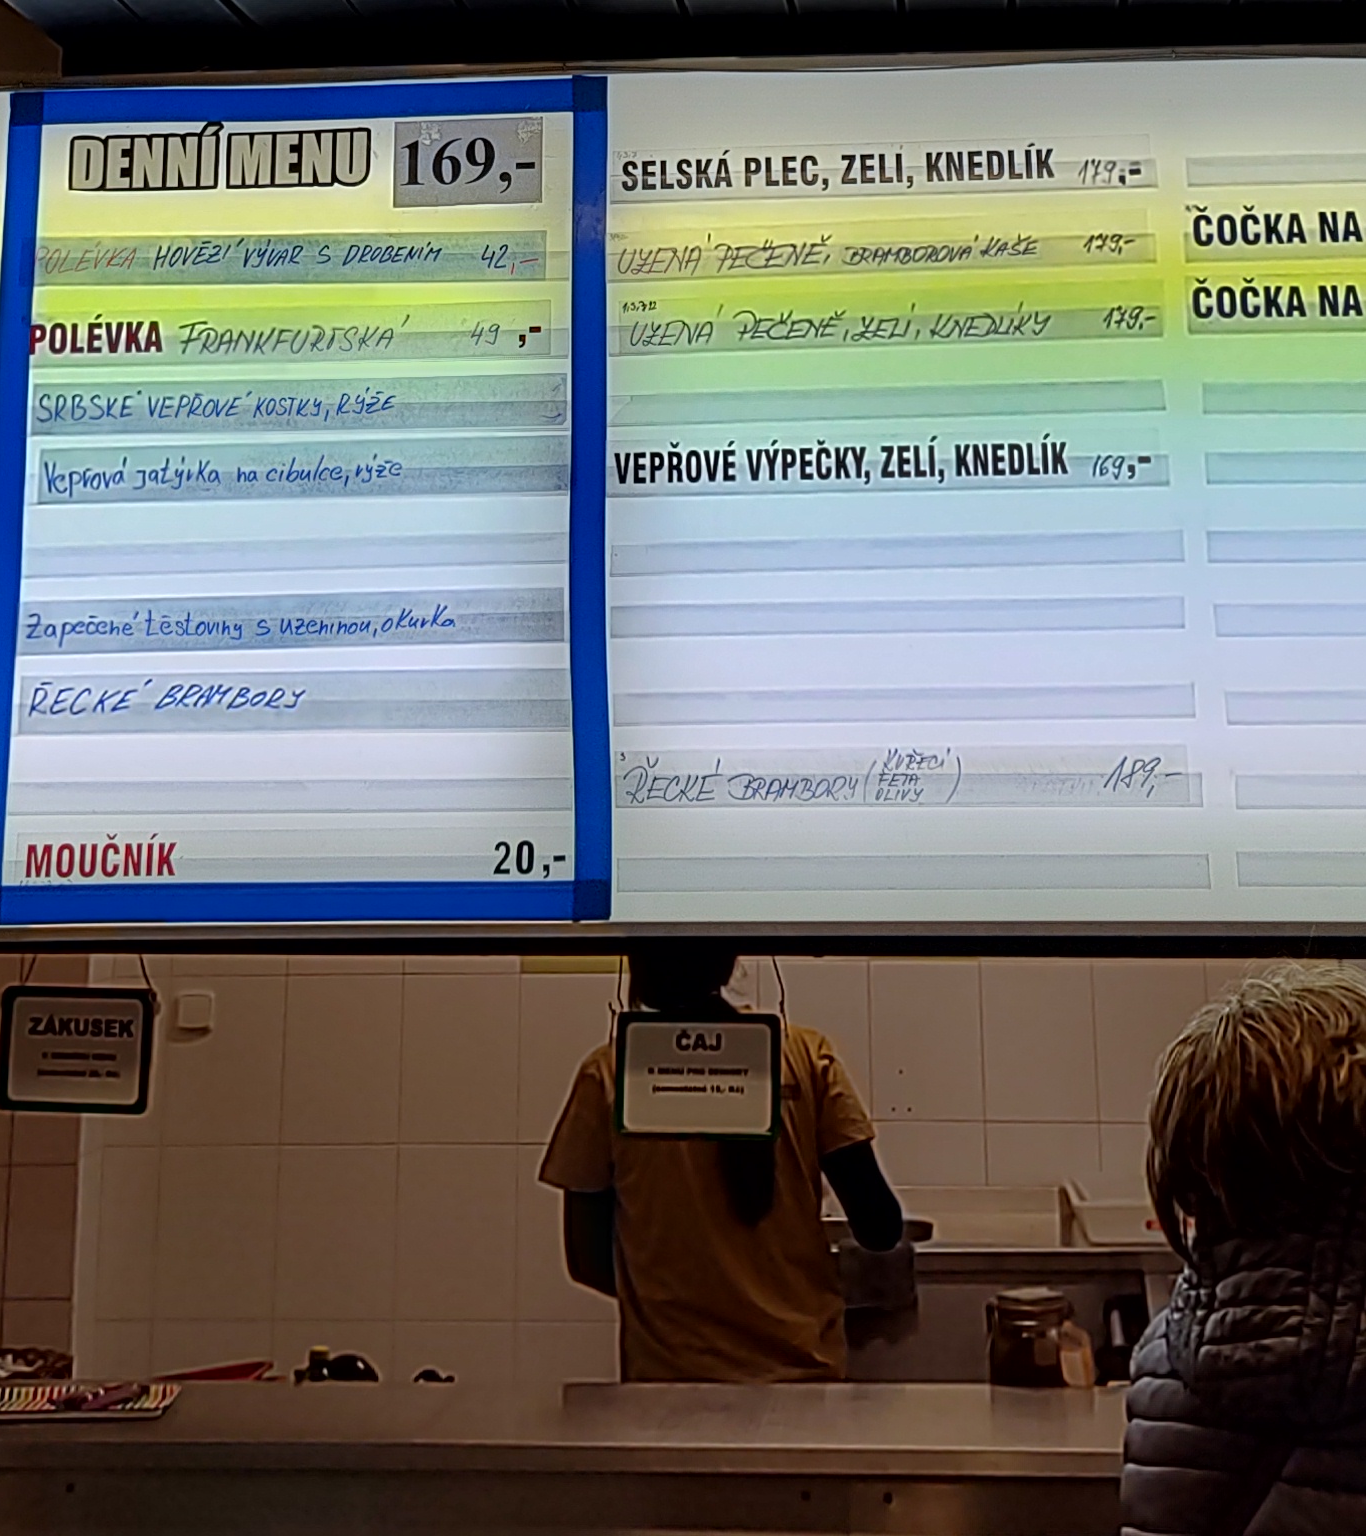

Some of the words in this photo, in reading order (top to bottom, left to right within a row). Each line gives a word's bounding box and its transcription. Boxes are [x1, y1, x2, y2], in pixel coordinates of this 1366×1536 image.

[68, 122, 225, 192] DENNÍ
[225, 128, 372, 189] MENU
[399, 137, 536, 194] 169,-
[621, 150, 733, 192] SELSKÁ
[744, 154, 829, 192] PLEC,
[841, 145, 915, 188] ZELÍ,
[925, 142, 1054, 183] KNEDLÍK
[1191, 205, 1307, 247] ČOČKA
[1318, 211, 1363, 243] NA
[242, 239, 304, 268] VÝVAR
[317, 244, 331, 263] S
[342, 242, 442, 266] DROBENÍM
[1191, 277, 1307, 318] ČOČKA
[1318, 284, 1363, 316] NA
[30, 313, 164, 356] POLÉVKA
[236, 464, 259, 484] na
[613, 441, 737, 485] VEPŘOVÉ
[745, 439, 871, 484] VÝPEČKY,
[880, 437, 946, 482] ZELÍ,
[954, 435, 1069, 477] KNEDLÍK
[155, 685, 307, 713] BRAMBORY
[24, 834, 178, 879] MOUČNÍK
[492, 840, 567, 880] 20,-
[28, 1014, 134, 1038] ZÁKUSEK
[675, 1029, 722, 1052] ČAJ
